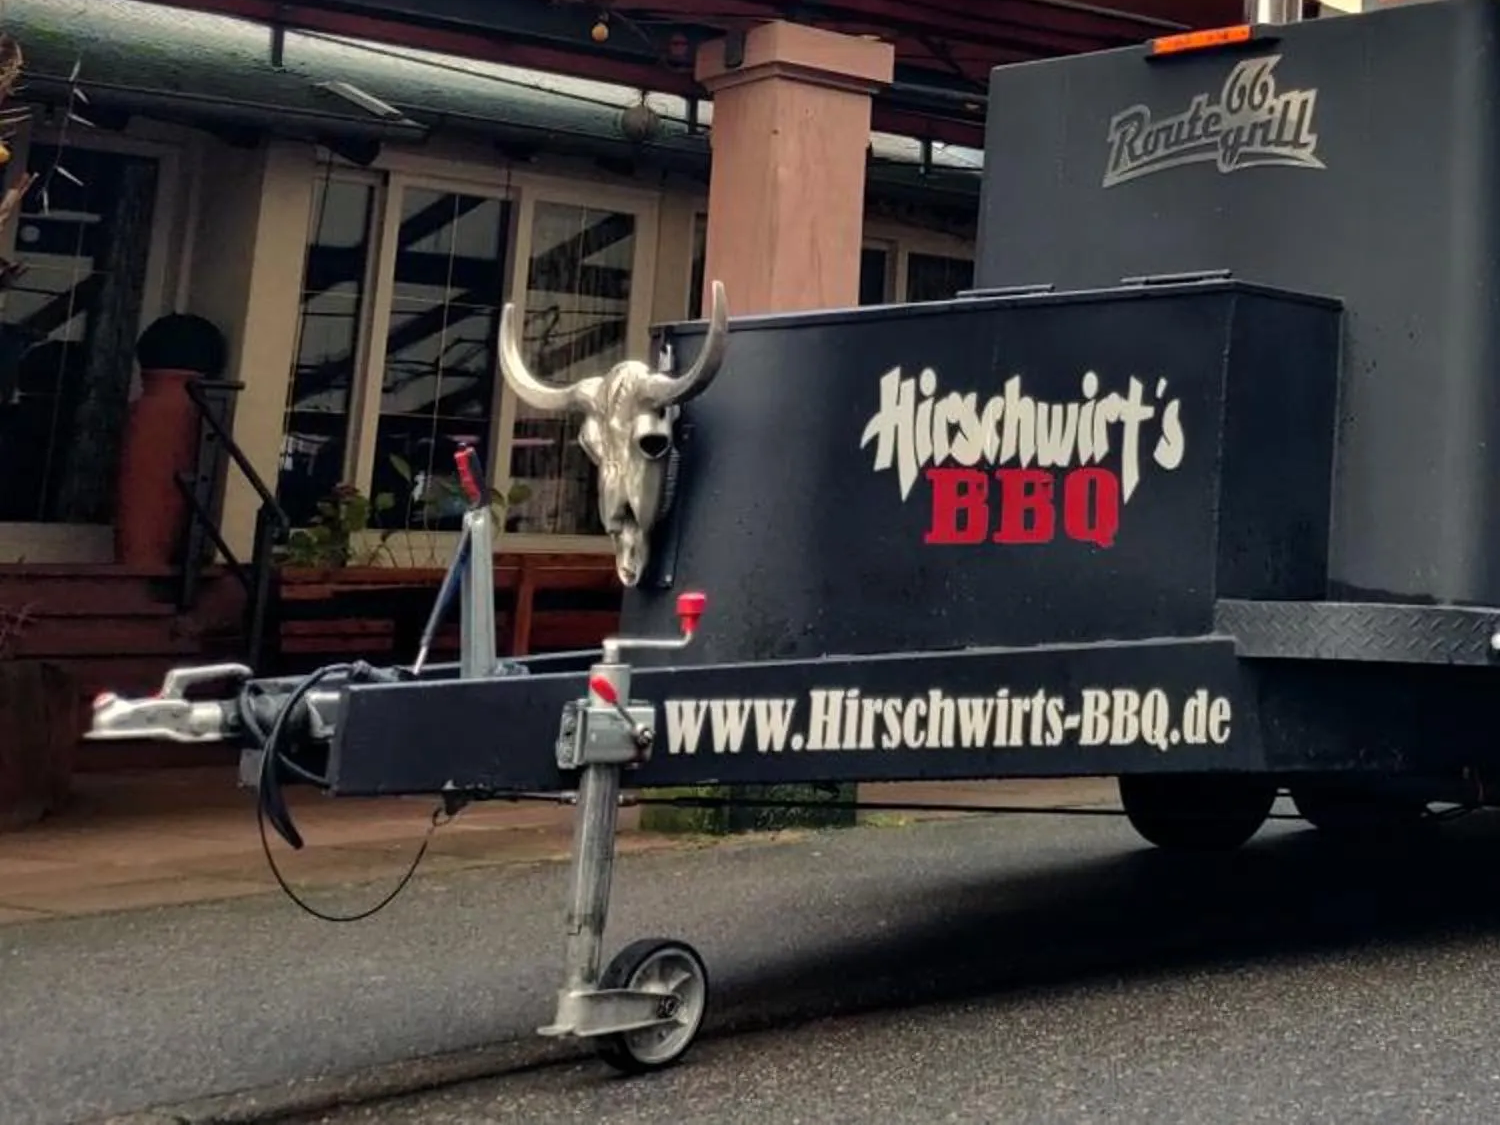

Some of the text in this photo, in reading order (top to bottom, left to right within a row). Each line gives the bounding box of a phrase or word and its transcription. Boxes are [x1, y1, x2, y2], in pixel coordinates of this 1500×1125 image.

[1111, 64, 1273, 173] Route 66
[1218, 98, 1310, 166] grill
[861, 366, 1185, 503] Hirschwirt's
[924, 468, 1119, 548] BBQ
[666, 688, 1232, 753] www.Hirschwirts-BBQ.de
